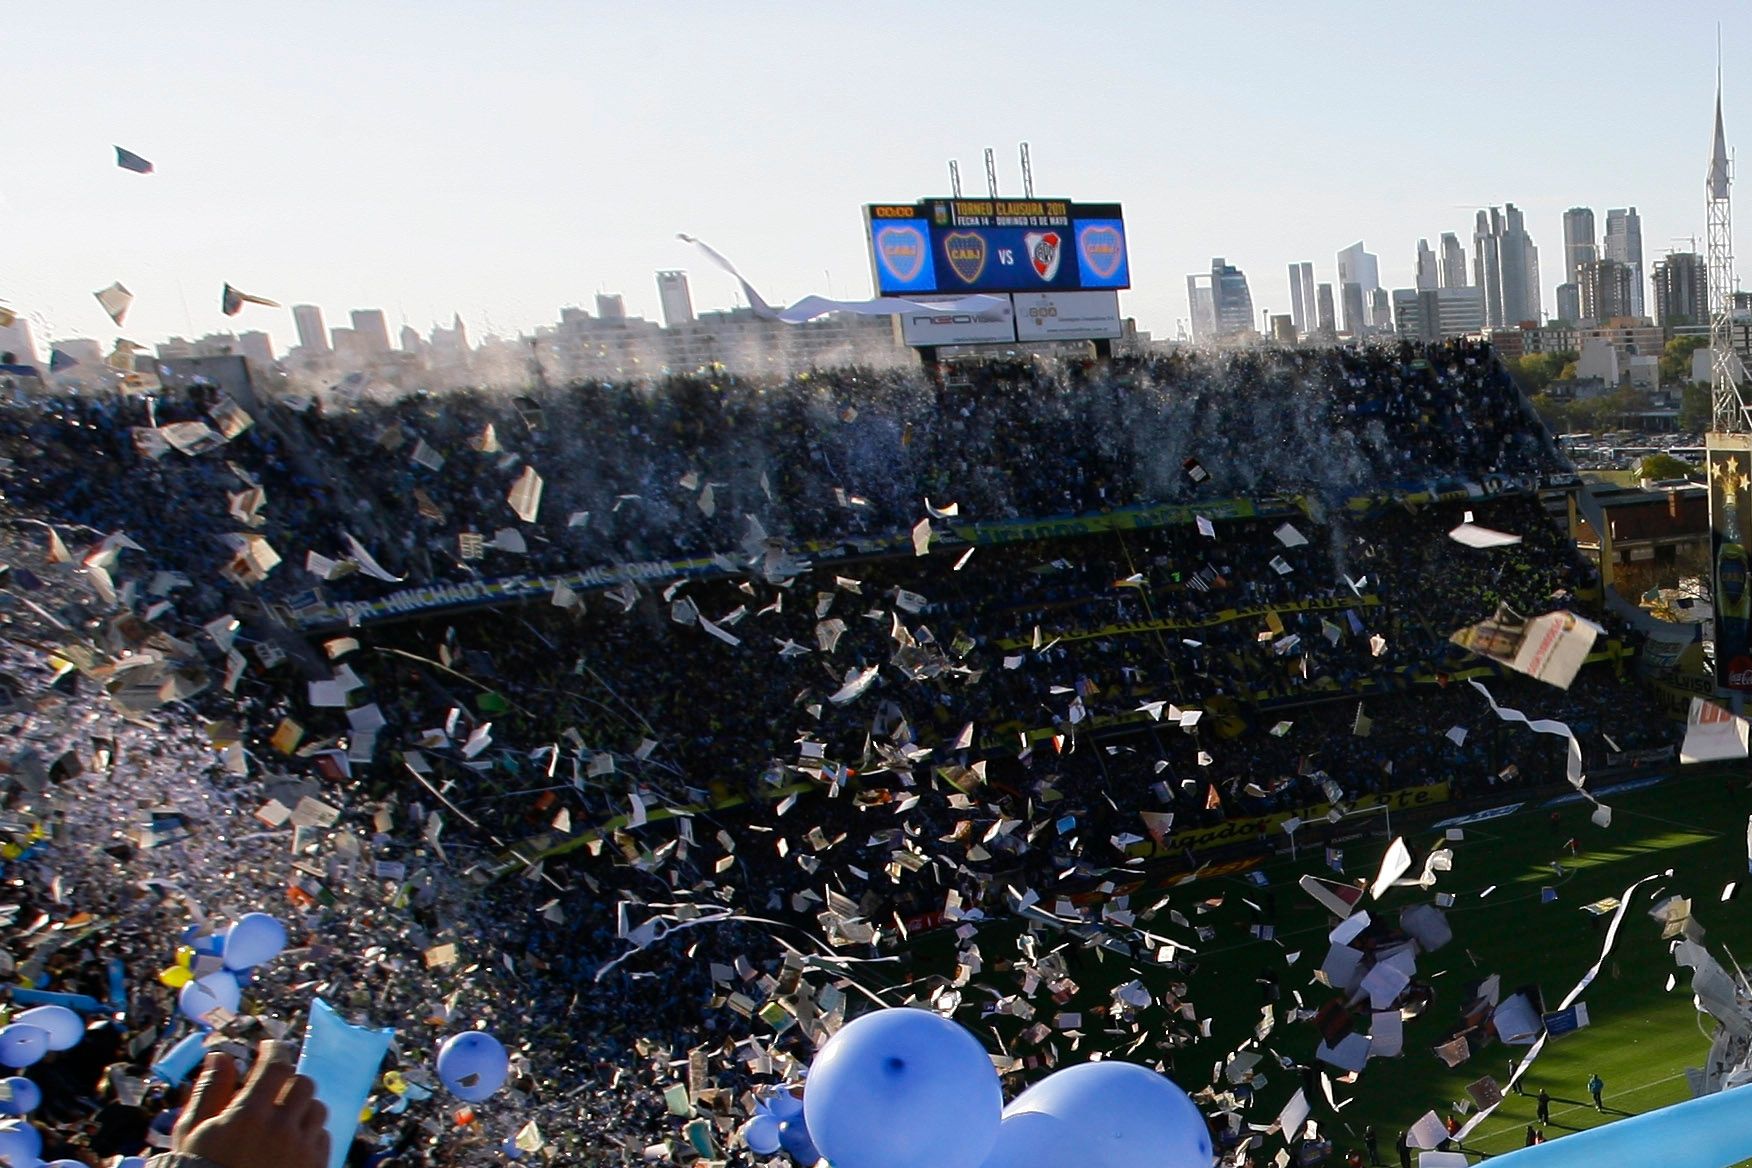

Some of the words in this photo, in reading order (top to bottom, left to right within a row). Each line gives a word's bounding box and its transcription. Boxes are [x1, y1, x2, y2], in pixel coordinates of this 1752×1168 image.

[876, 207, 914, 218] 00:00
[957, 202, 994, 216] TORNEO
[996, 202, 1044, 216] CLAUSURA
[1047, 202, 1066, 216] 2011
[958, 216, 980, 226] FECHA
[1050, 216, 1069, 226] MAYO
[998, 250, 1014, 266] VS
